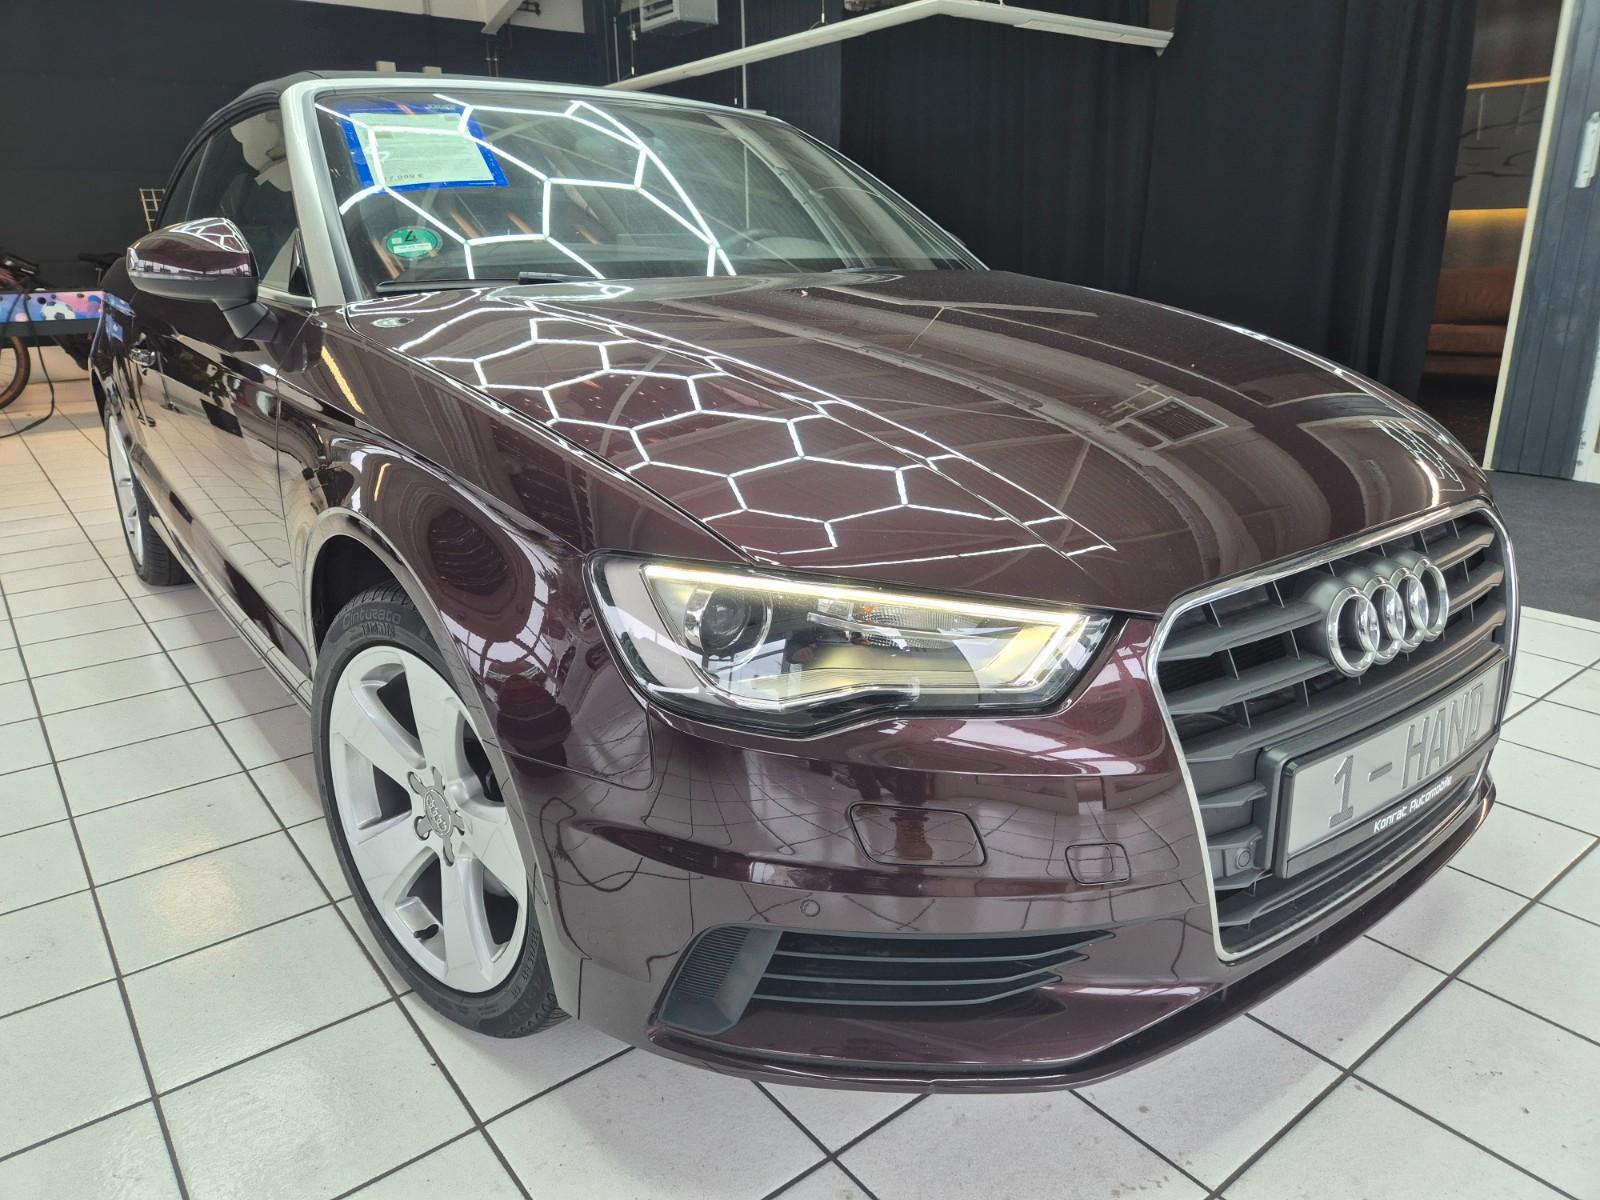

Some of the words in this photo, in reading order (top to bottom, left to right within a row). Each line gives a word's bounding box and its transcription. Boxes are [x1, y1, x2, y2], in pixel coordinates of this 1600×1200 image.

[404, 230, 417, 242] 4
[343, 608, 401, 626] Cinturato
[1328, 754, 1354, 828] 1
[1401, 682, 1483, 789] HAND
